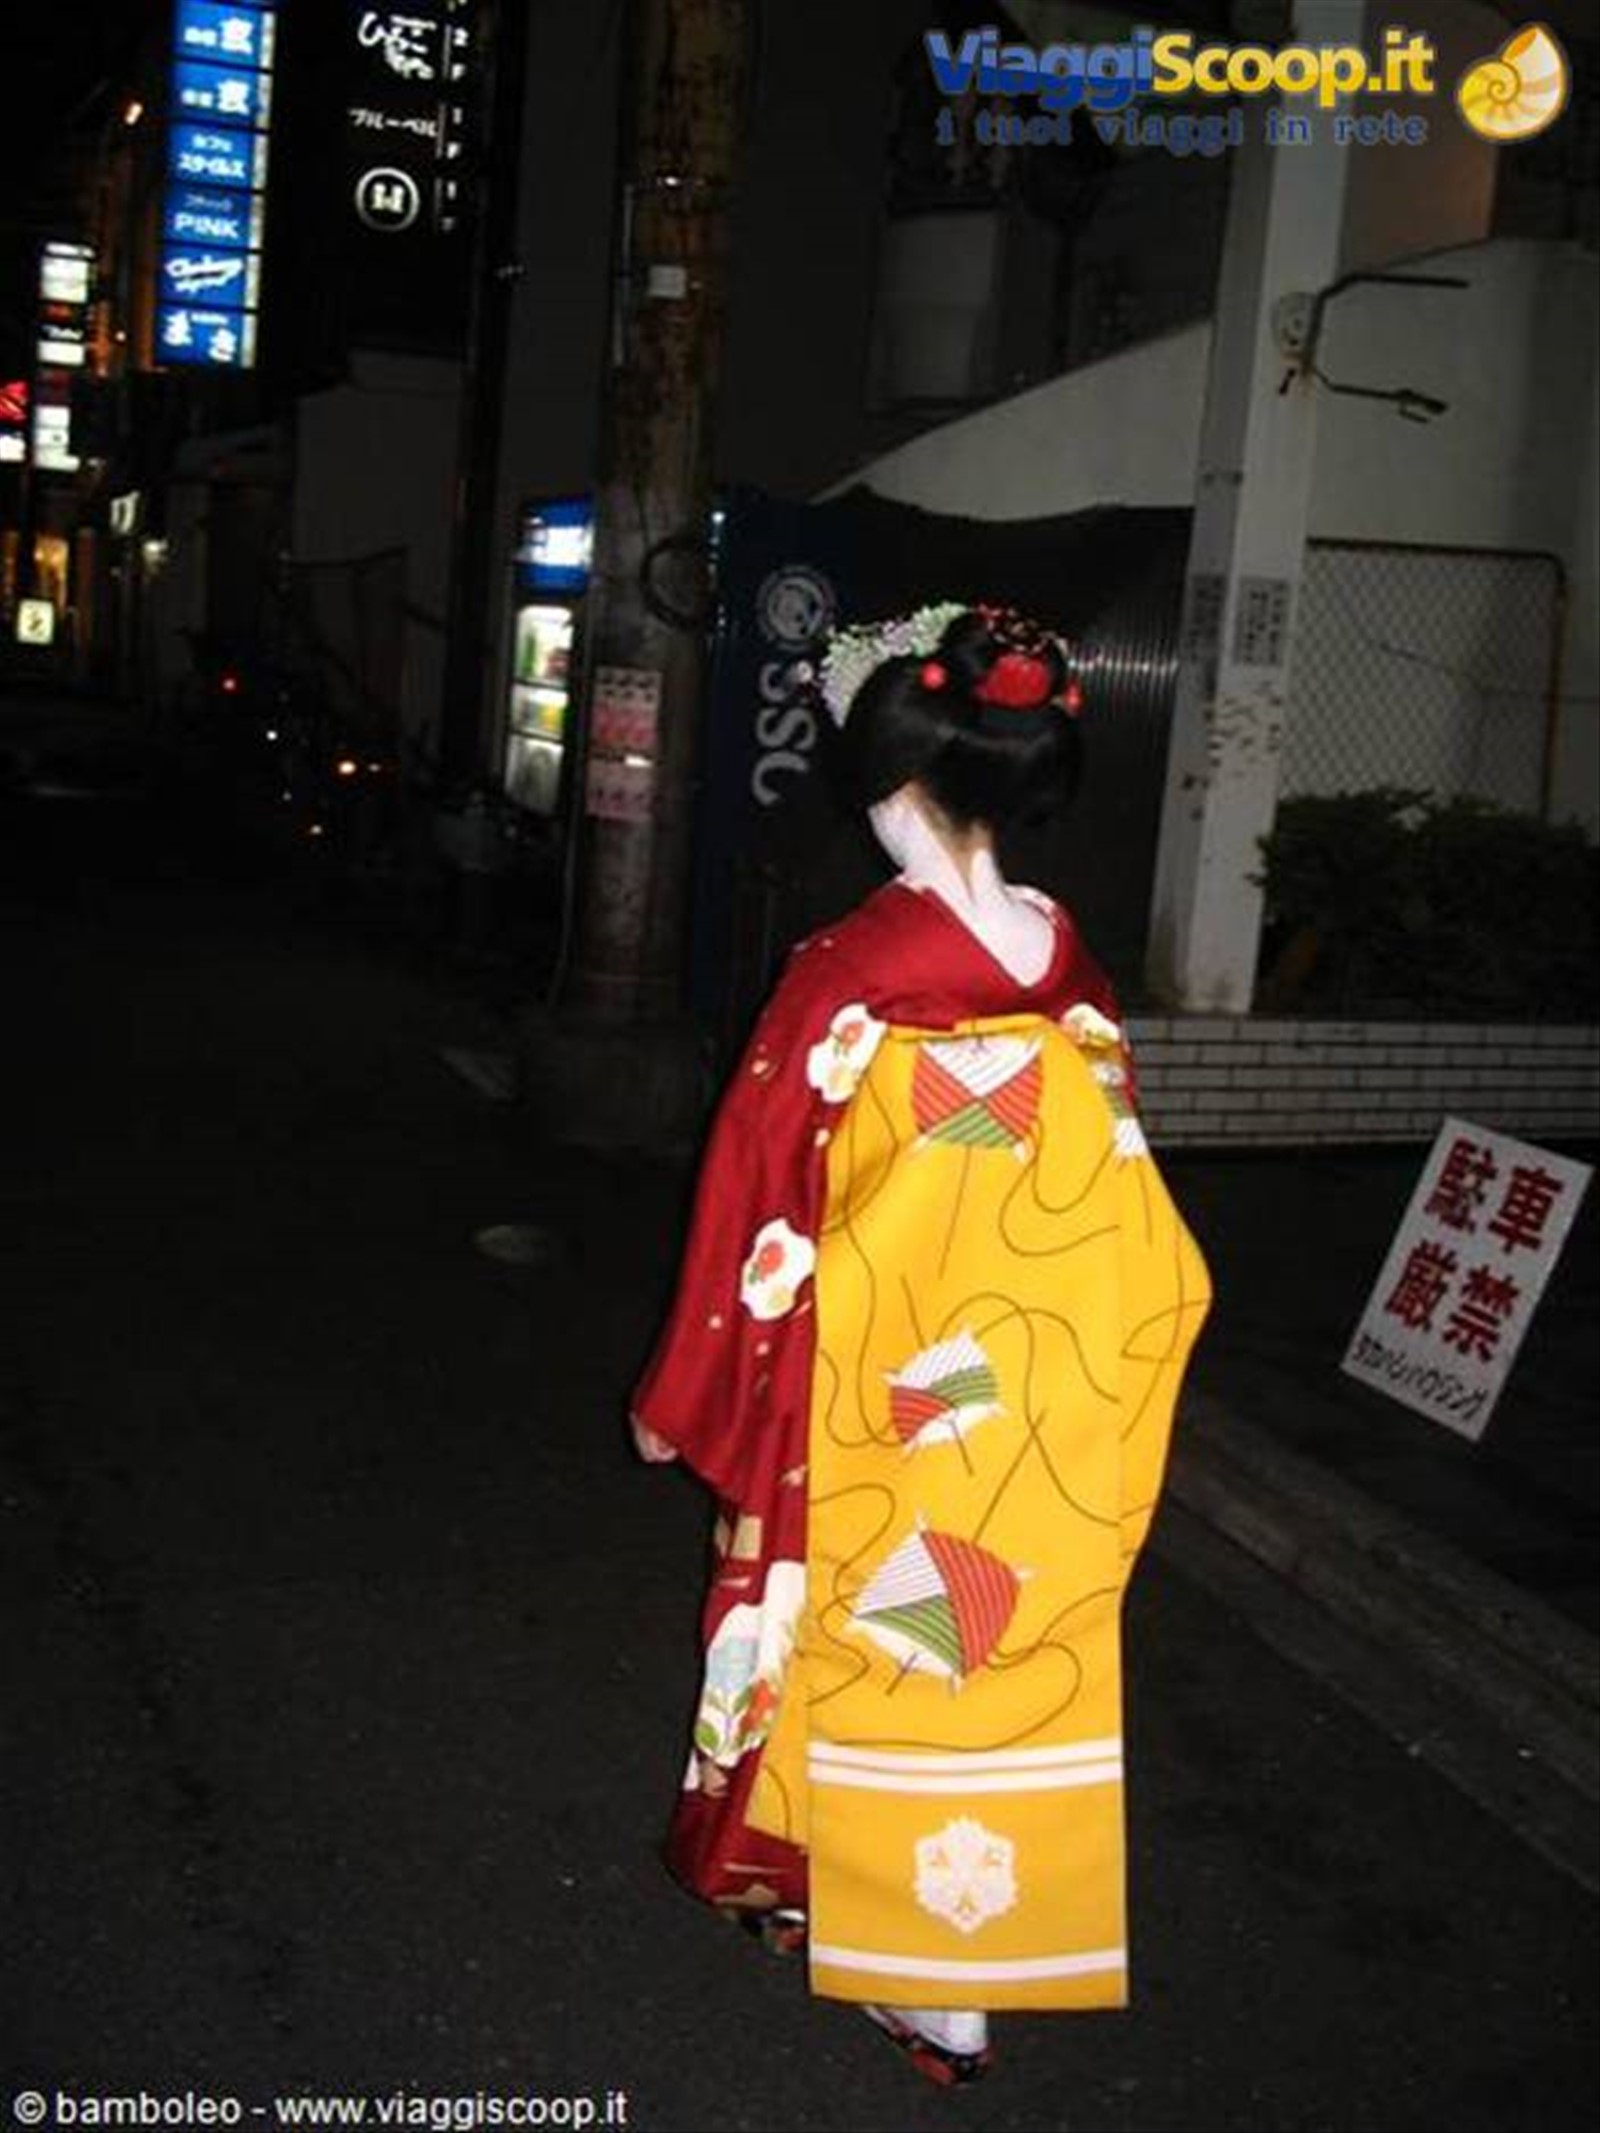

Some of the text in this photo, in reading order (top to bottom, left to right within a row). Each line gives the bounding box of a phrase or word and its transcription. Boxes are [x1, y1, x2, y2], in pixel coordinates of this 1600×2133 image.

[174, 212, 240, 238] PINK
[1423, 1136, 1564, 1254] 駐車
[1383, 1239, 1520, 1363] 厳禁
